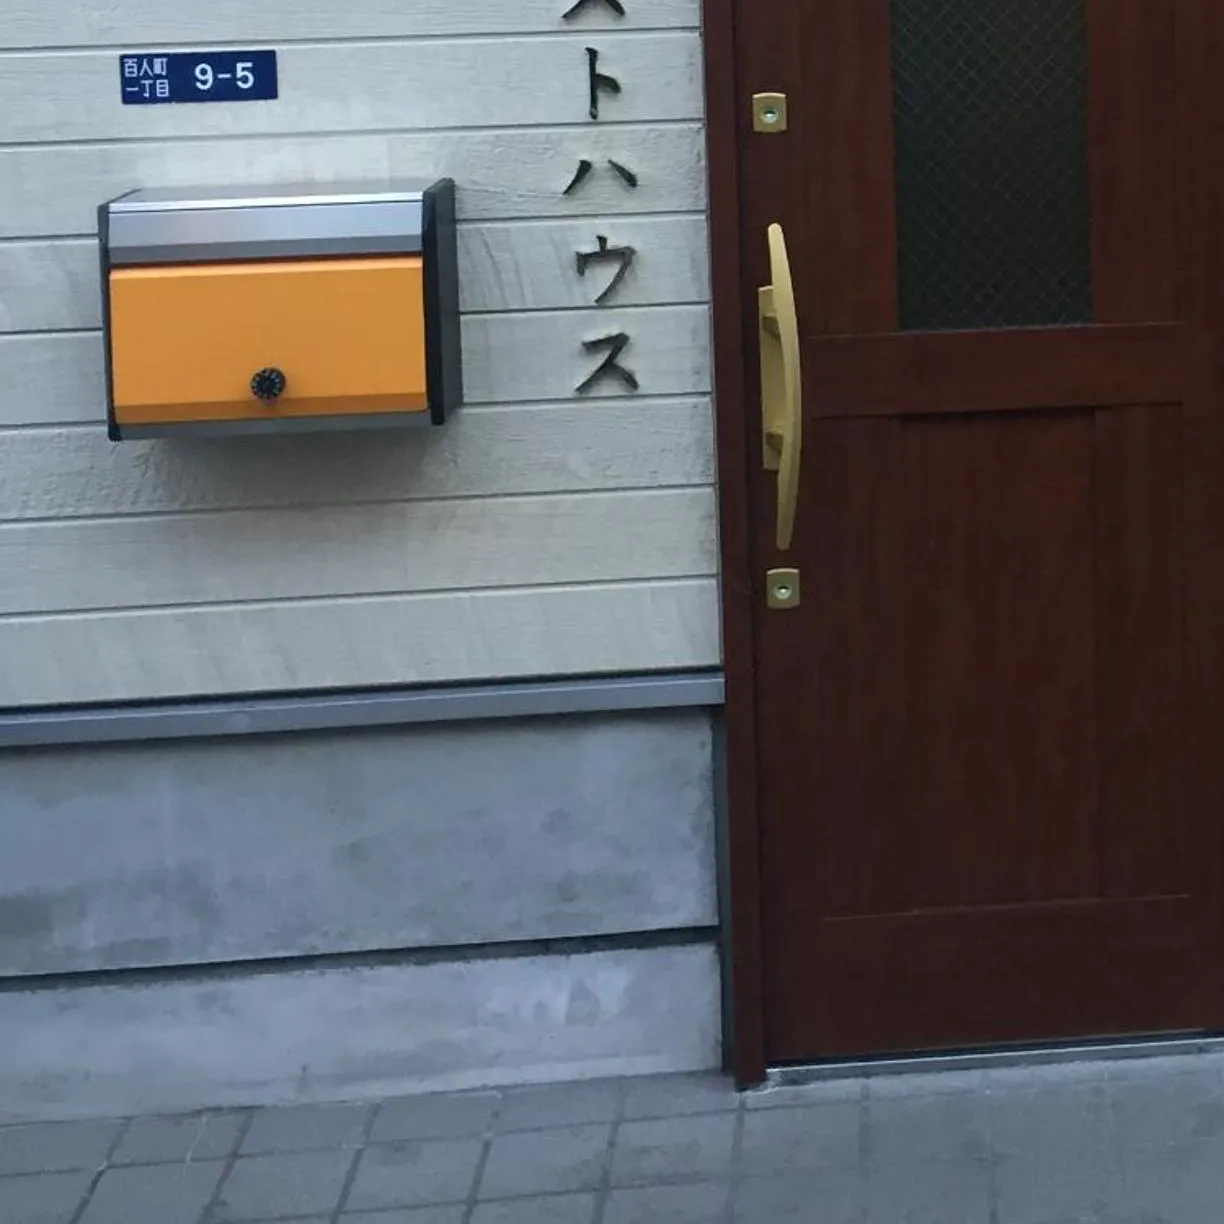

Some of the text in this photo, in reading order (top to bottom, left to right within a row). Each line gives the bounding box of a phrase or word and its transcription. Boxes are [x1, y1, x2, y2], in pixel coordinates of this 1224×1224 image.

[123, 58, 168, 77] 百人町
[194, 62, 254, 90] 9-5
[125, 79, 169, 97] 一丁目
